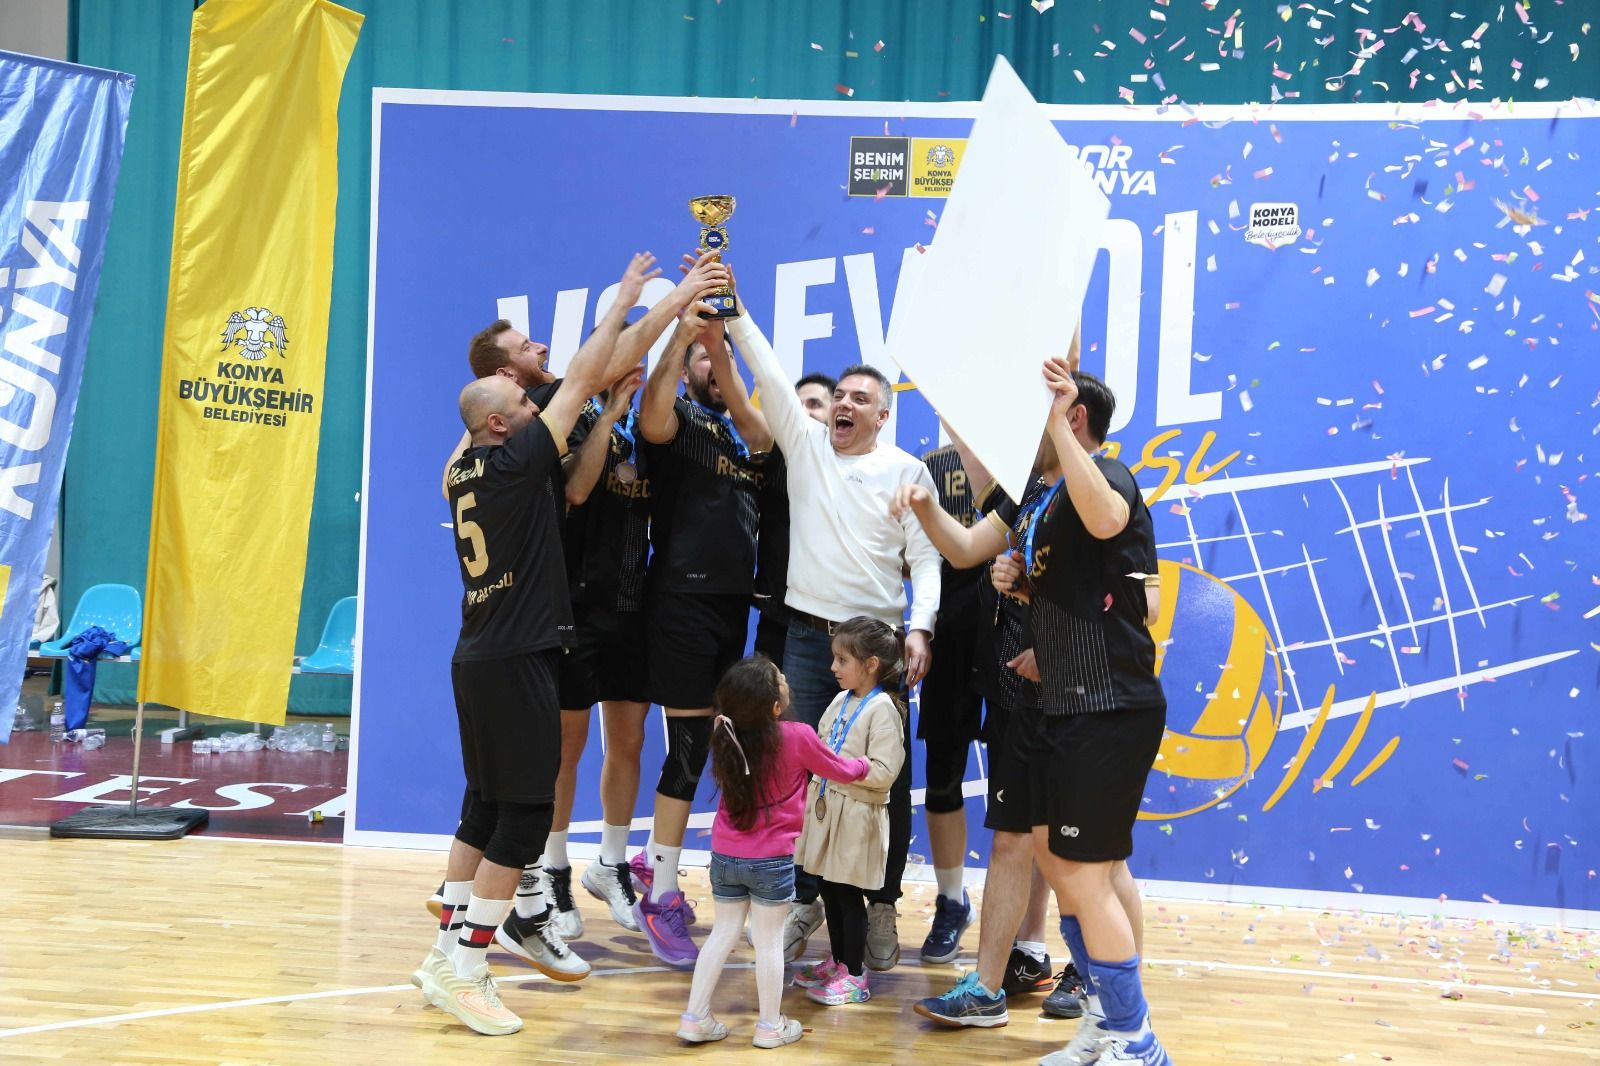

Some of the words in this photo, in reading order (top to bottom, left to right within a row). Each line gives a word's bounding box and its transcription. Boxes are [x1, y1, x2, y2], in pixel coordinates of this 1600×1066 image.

[854, 151, 904, 166] BENİM
[1066, 144, 1133, 169] OR
[1086, 161, 1157, 195] NYA
[1252, 217, 1295, 227] MODELİ
[1253, 207, 1295, 218] KONYA
[496, 209, 1222, 447] VOEYOL
[217, 361, 284, 385] KONYA
[180, 376, 313, 413] BÜYÜKŞEHİR
[203, 407, 286, 427] BELEDİYESİ
[945, 470, 966, 497] 12
[457, 491, 489, 578] 5
